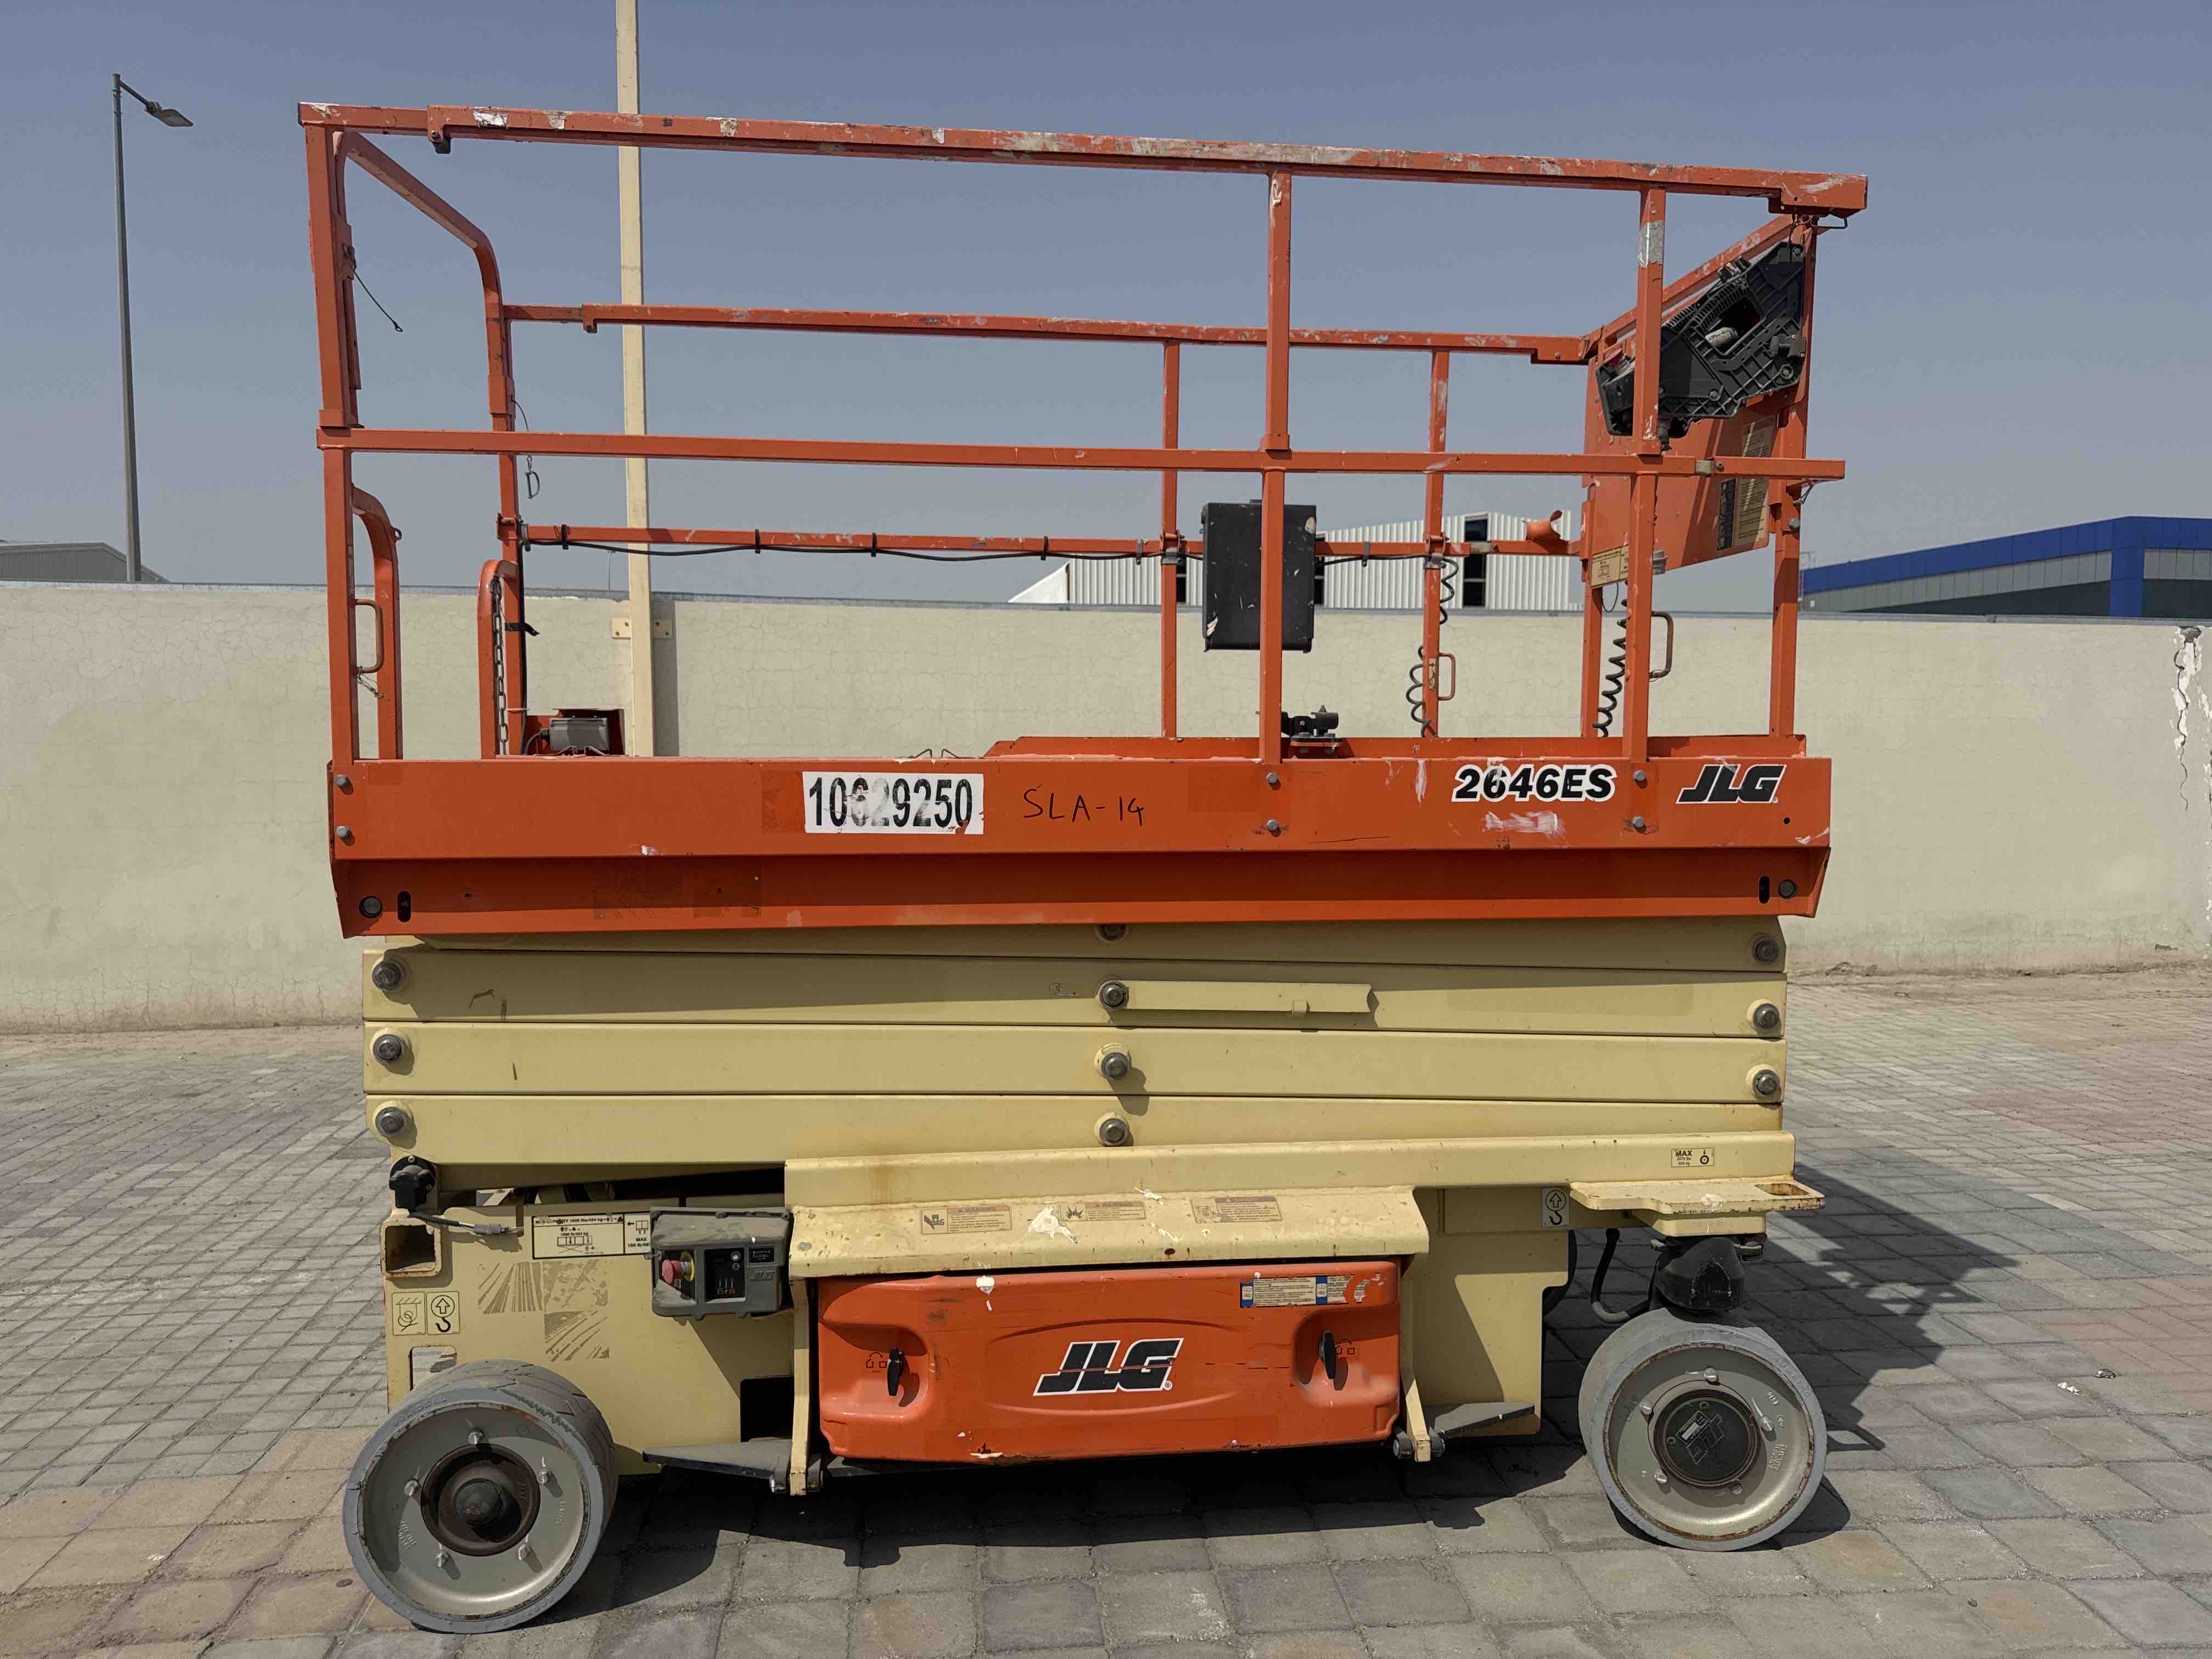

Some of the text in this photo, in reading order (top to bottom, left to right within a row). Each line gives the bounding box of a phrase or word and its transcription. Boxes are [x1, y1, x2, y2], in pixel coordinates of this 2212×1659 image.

[1452, 764, 1618, 803] 2646ES
[1676, 764, 1787, 804] JLG
[1032, 1338, 1184, 1396] JLG
